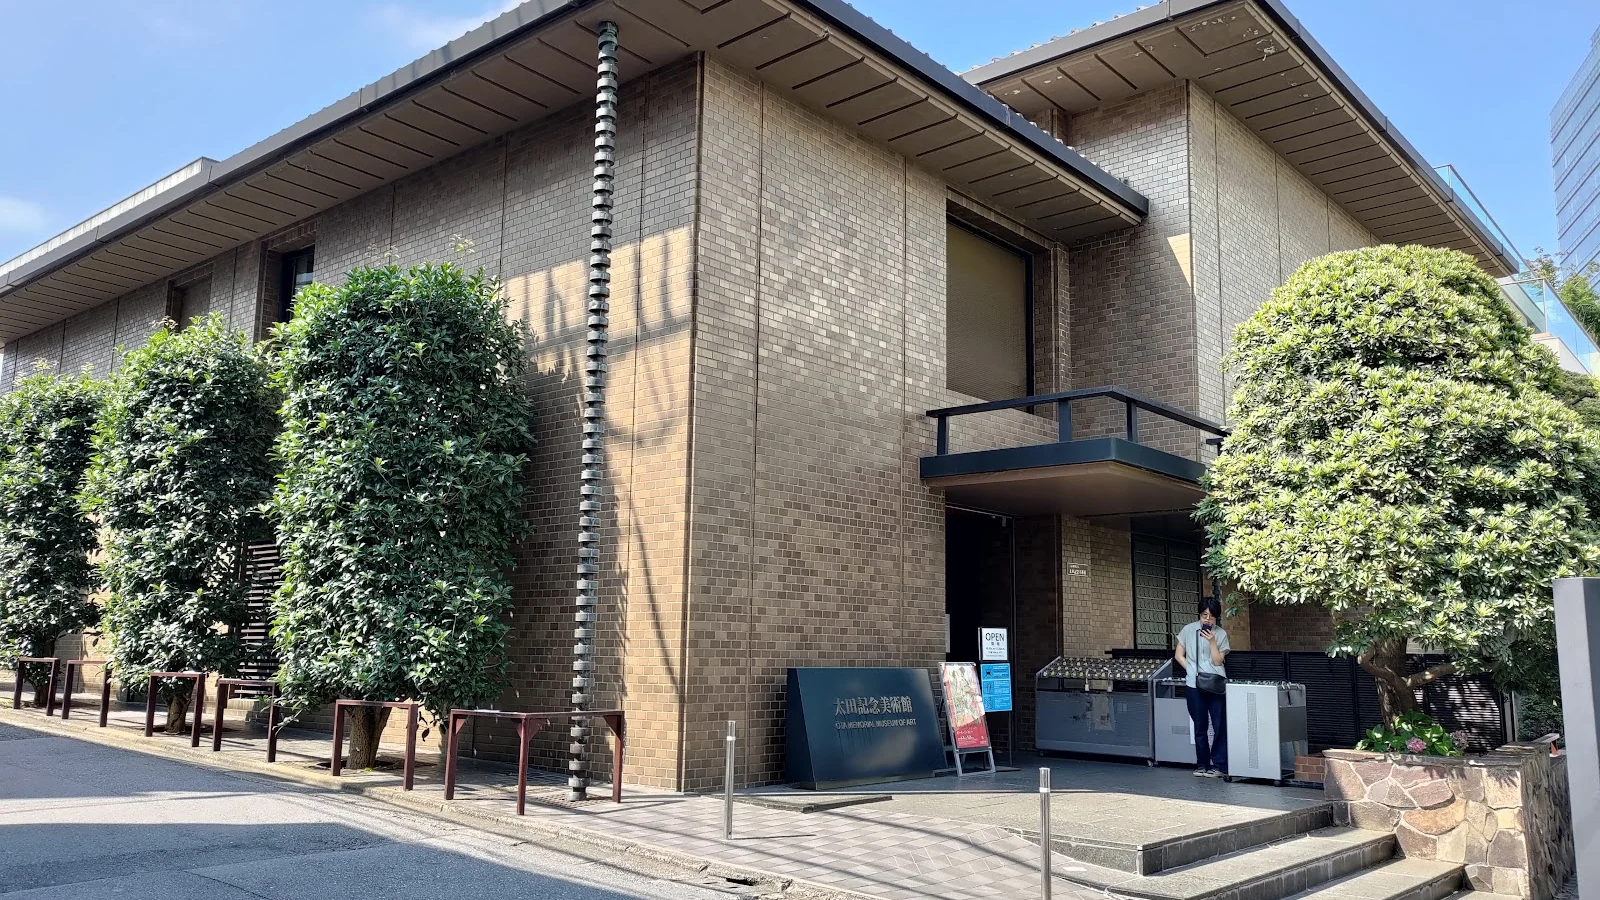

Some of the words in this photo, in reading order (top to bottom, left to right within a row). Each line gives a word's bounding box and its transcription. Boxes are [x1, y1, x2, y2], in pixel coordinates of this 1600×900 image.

[985, 632, 1005, 641] OPEN
[833, 695, 913, 716] 太田記念美術館
[848, 720, 876, 729] MEMORIAL
[876, 719, 898, 728] MUSEUM
[898, 719, 906, 727] OF
[906, 718, 917, 726] ART
